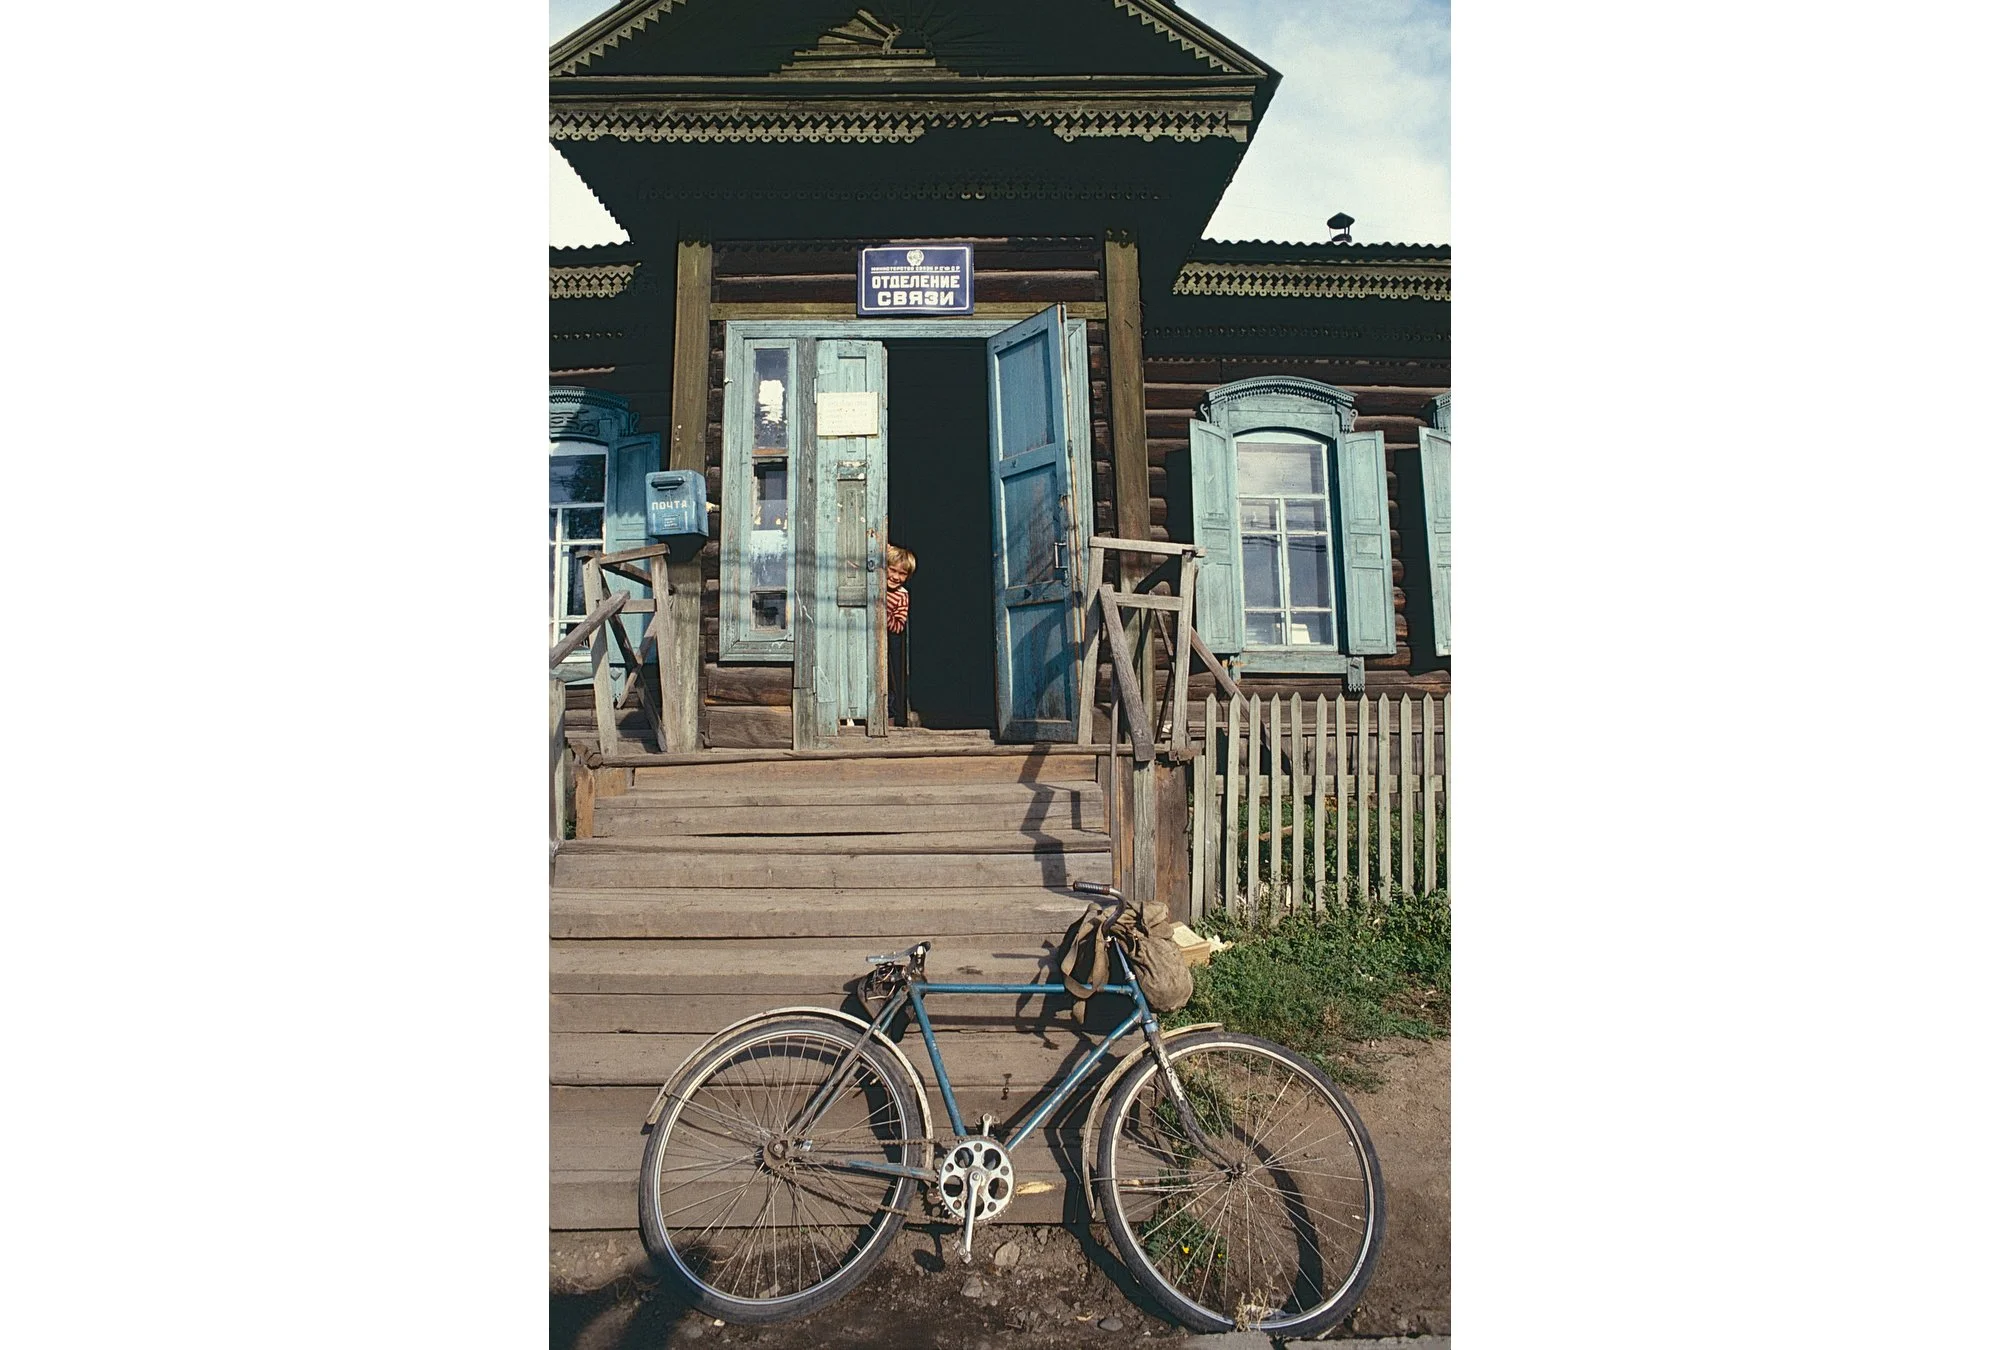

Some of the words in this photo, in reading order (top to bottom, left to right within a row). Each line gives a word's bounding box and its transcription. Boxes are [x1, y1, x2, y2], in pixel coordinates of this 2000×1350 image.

[871, 275, 960, 289] ОТДЕЛЕНИЕ
[877, 291, 954, 306] СВЯЗИ
[651, 500, 687, 510] ПОЧТА
